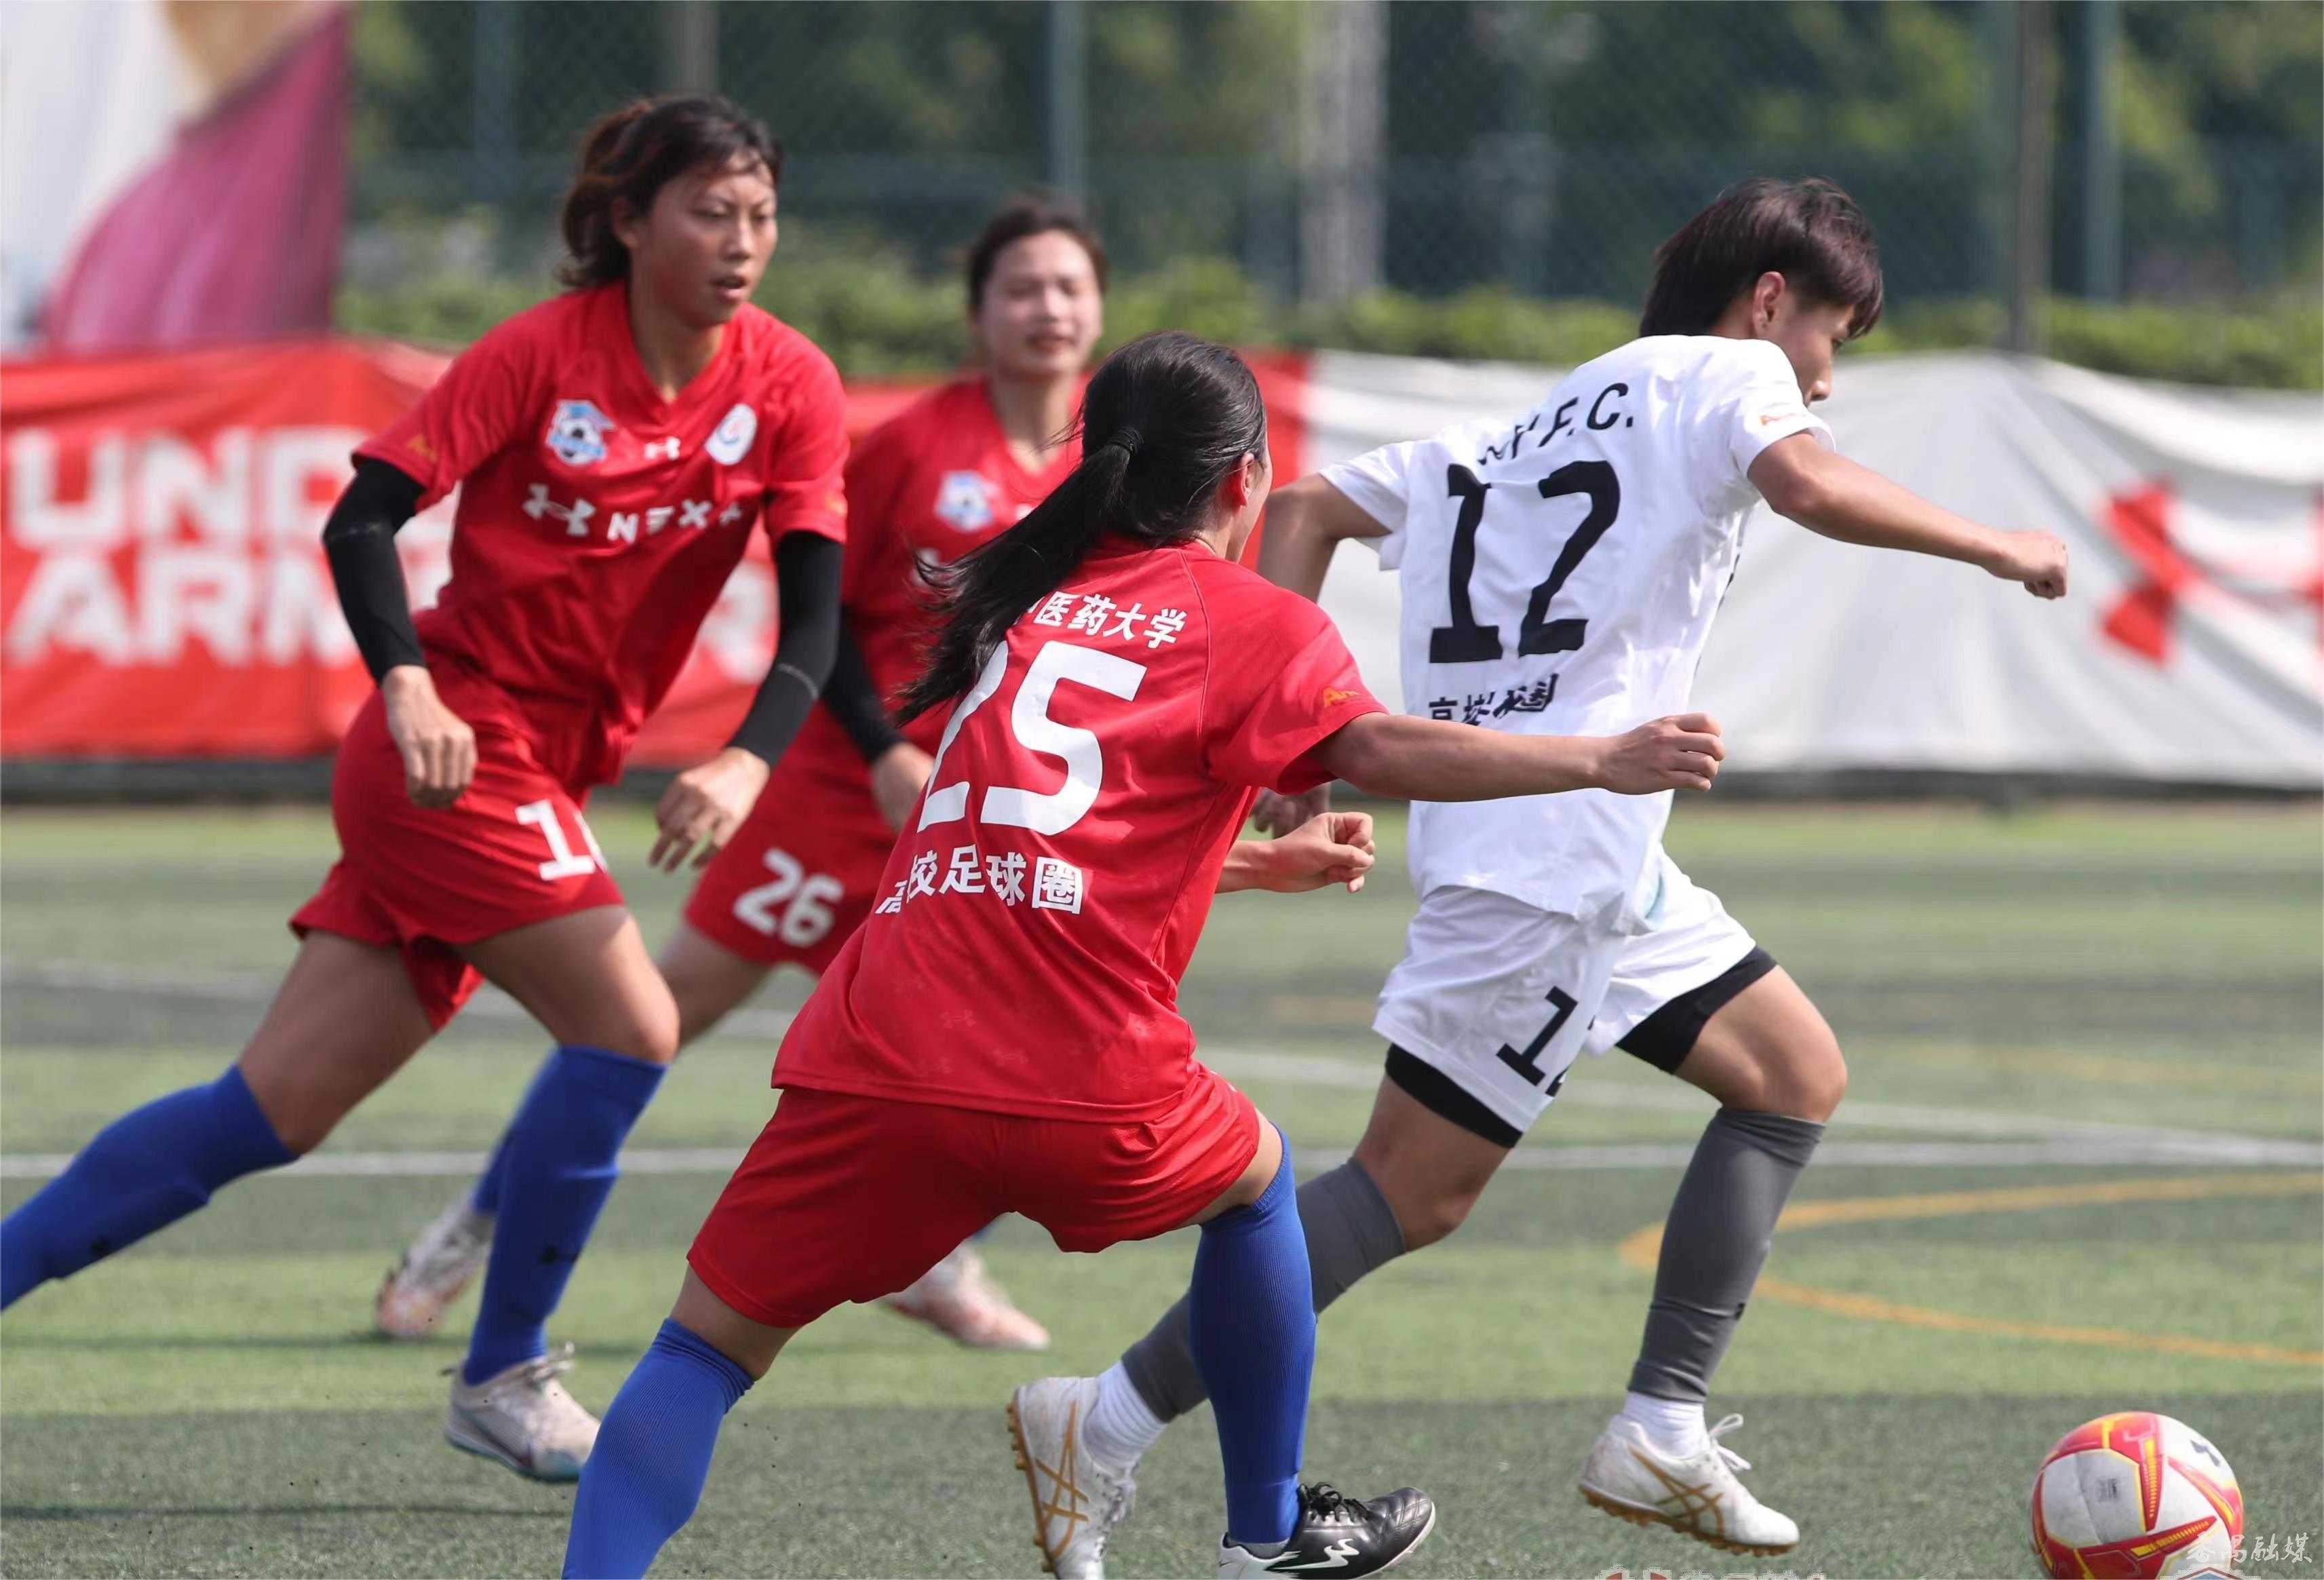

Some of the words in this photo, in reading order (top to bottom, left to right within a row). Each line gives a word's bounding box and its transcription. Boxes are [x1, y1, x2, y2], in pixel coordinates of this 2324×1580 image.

[8, 427, 453, 543] UND
[1429, 459, 1621, 663] 12
[1026, 590, 1188, 649] 医药大学
[916, 640, 1148, 836] 25
[733, 847, 845, 948] 26
